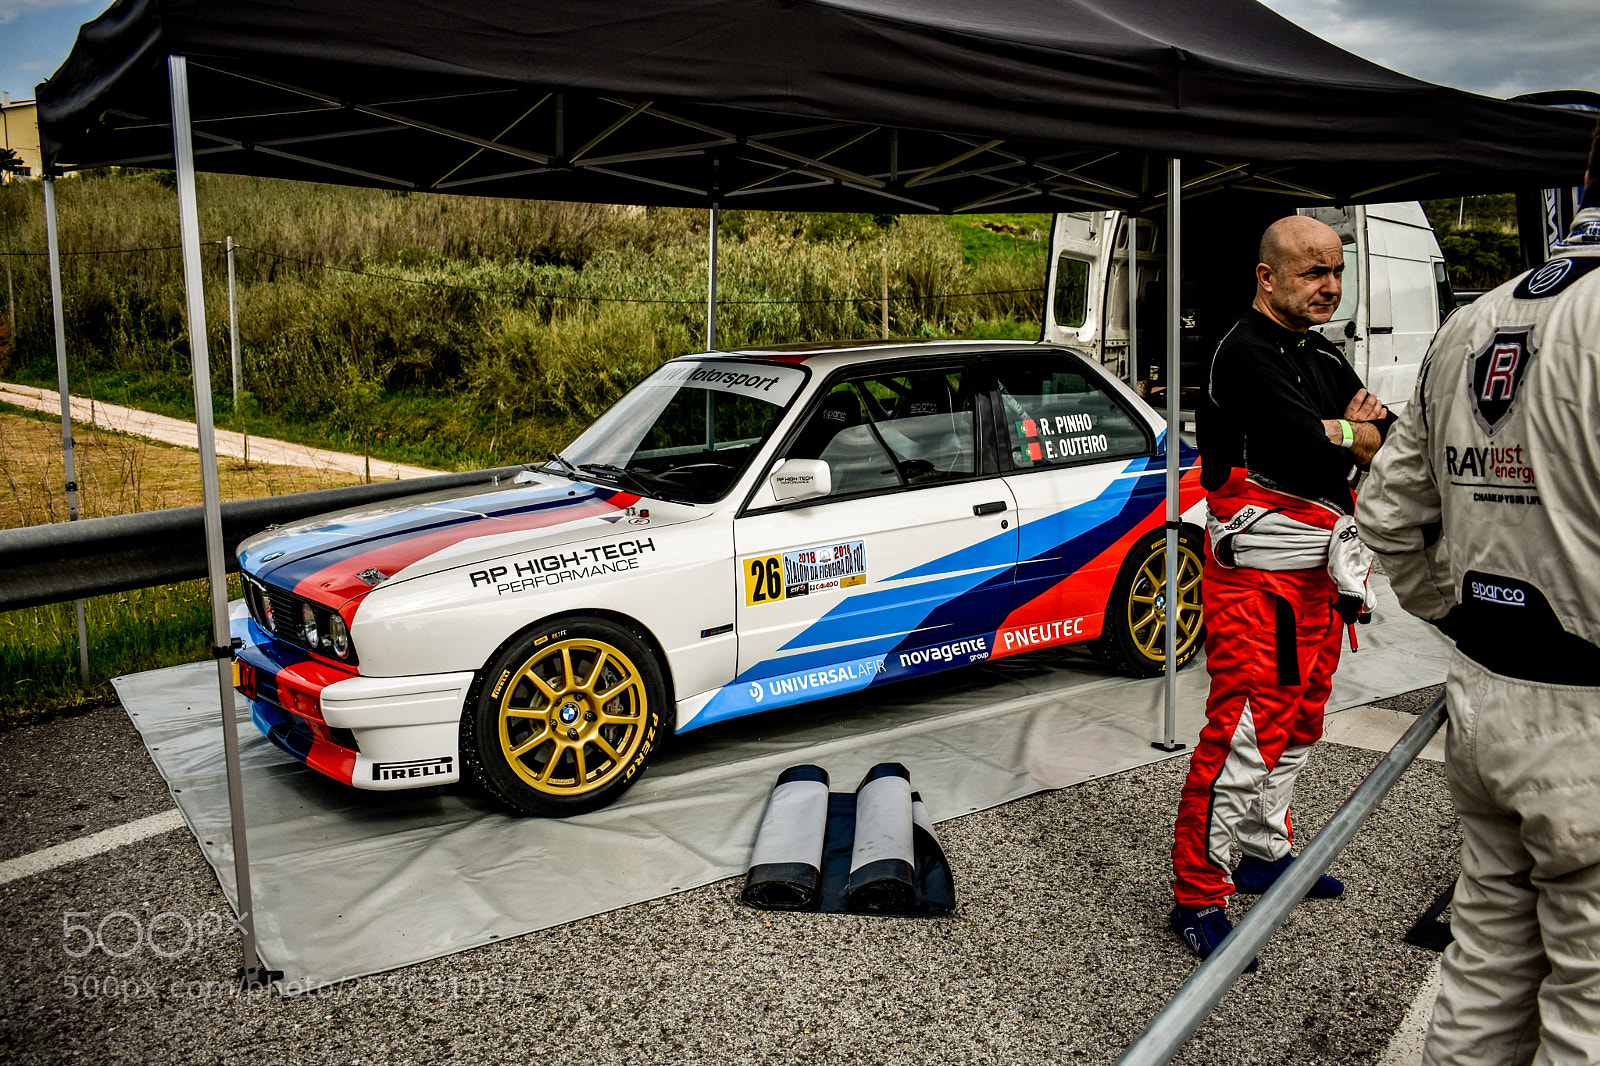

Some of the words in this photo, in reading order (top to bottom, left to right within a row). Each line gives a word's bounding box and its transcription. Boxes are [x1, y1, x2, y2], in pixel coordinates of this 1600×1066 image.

[1481, 343, 1521, 401] R
[1040, 418, 1055, 436] R.
[1055, 413, 1093, 434] PINHO
[1045, 440, 1059, 459] E.
[1059, 434, 1108, 457] OUTEIRO
[1446, 445, 1489, 477] RAY
[1489, 441, 1523, 470] just
[1224, 508, 1257, 531] sparco
[469, 566, 508, 588] RP
[514, 537, 656, 577] HIGH-TECH
[798, 551, 816, 564] 2018
[497, 558, 640, 596] PERFORMANCE
[751, 557, 782, 602] 26
[1472, 581, 1525, 604] sparco
[1003, 617, 1084, 650] PNEUTEC
[900, 637, 986, 667] novagente
[969, 651, 989, 663] group
[769, 664, 857, 696] UNIVERSAL
[371, 756, 453, 780] PIRELLI
